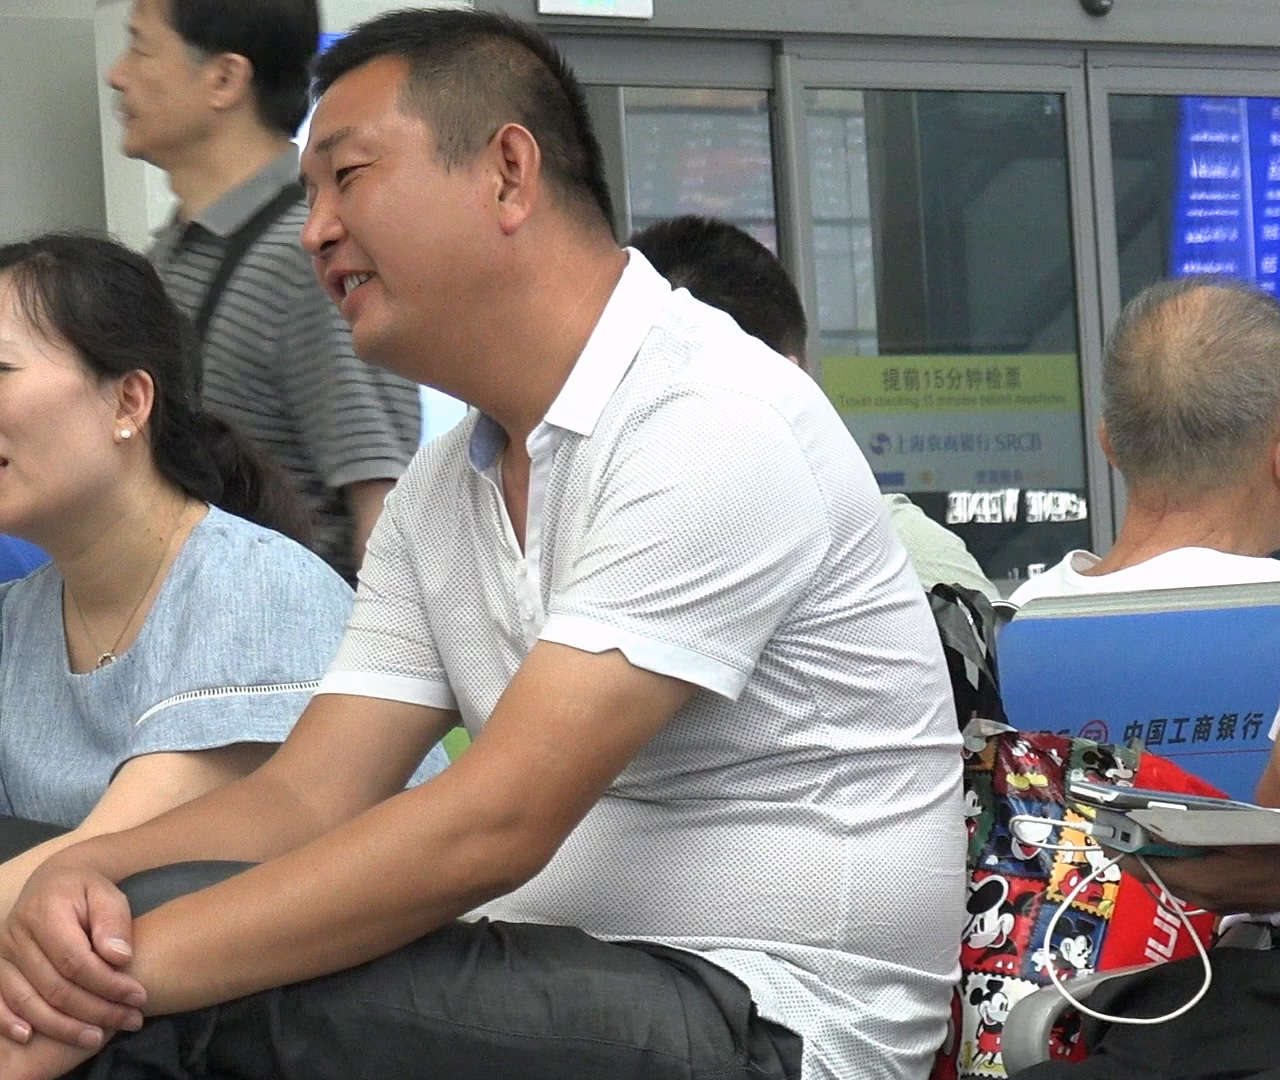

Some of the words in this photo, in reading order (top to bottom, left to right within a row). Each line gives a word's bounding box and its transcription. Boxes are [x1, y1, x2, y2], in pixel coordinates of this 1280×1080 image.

[1122, 712, 1264, 748] 中国工商银行
